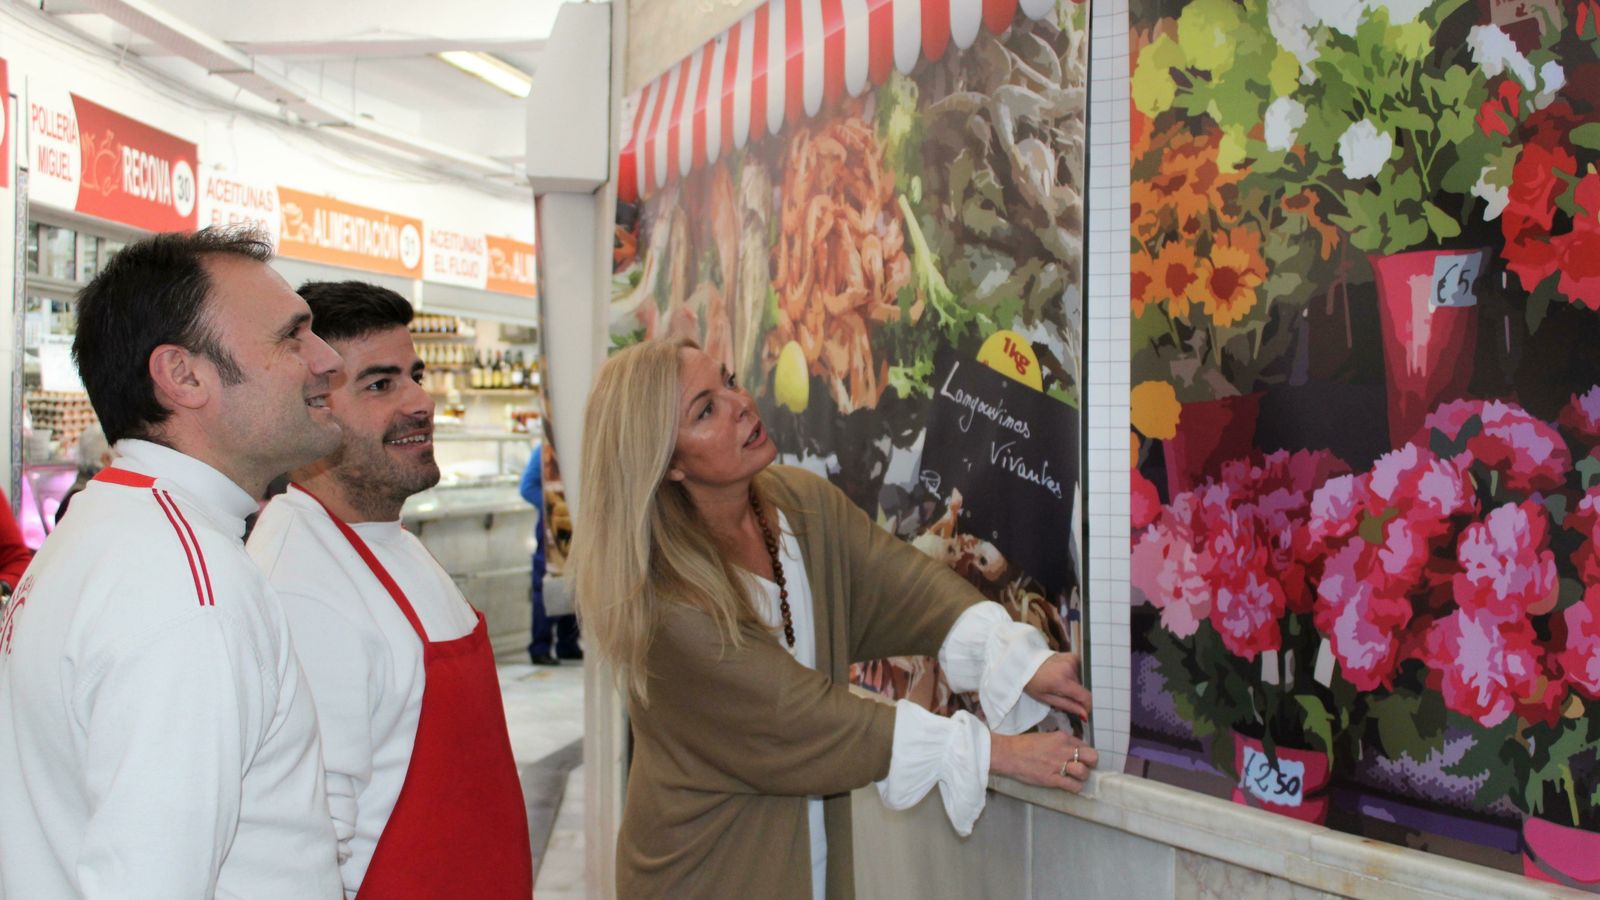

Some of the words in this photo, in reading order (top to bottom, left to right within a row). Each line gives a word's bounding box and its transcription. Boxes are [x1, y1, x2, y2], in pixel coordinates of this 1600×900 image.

[38, 144, 73, 182] MIGUEL
[123, 146, 172, 206] RECOVA
[177, 175, 190, 203] 30
[207, 176, 273, 212] ACEITUNAS
[313, 207, 398, 259] ALIMENTACIÓN
[429, 229, 484, 256] ACEITUNAS
[434, 253, 446, 273] EL
[1003, 336, 1031, 375] 1kg
